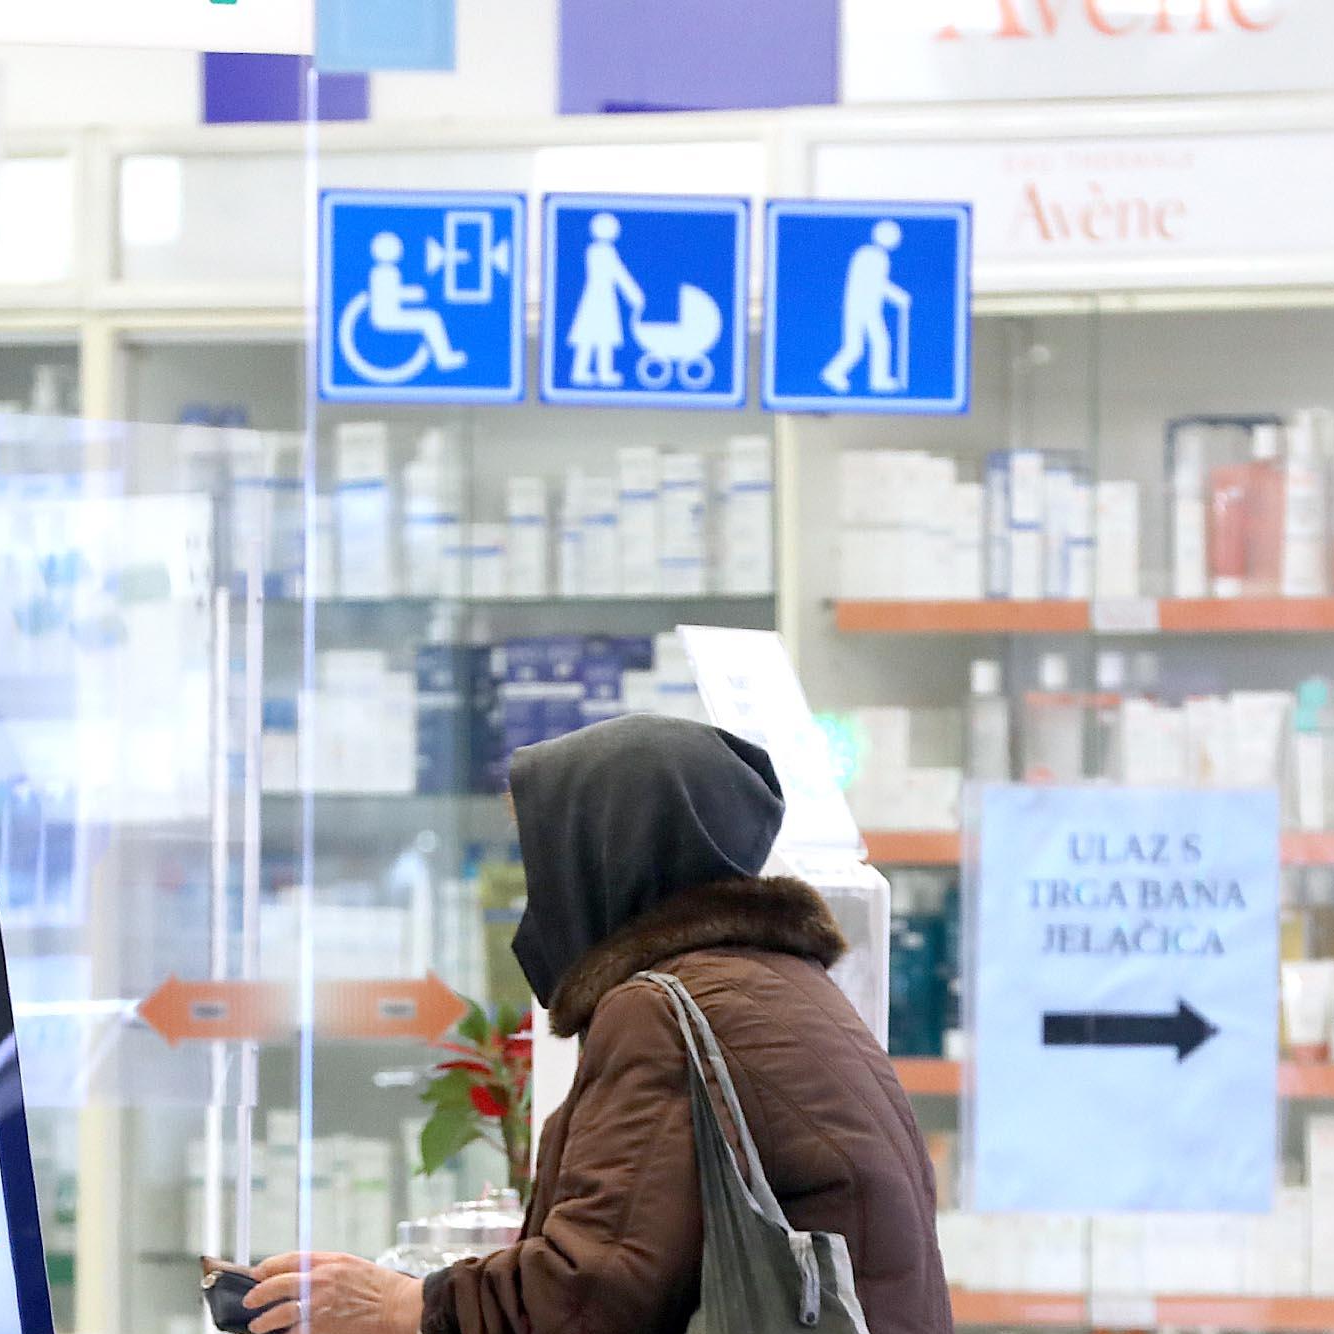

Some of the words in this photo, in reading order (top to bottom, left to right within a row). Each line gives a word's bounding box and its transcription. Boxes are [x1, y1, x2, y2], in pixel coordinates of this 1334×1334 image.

[1068, 832, 1168, 864] ULAZ
[1181, 833, 1203, 863] S
[1025, 878, 1128, 910] TRGA
[1137, 877, 1248, 910] BANA
